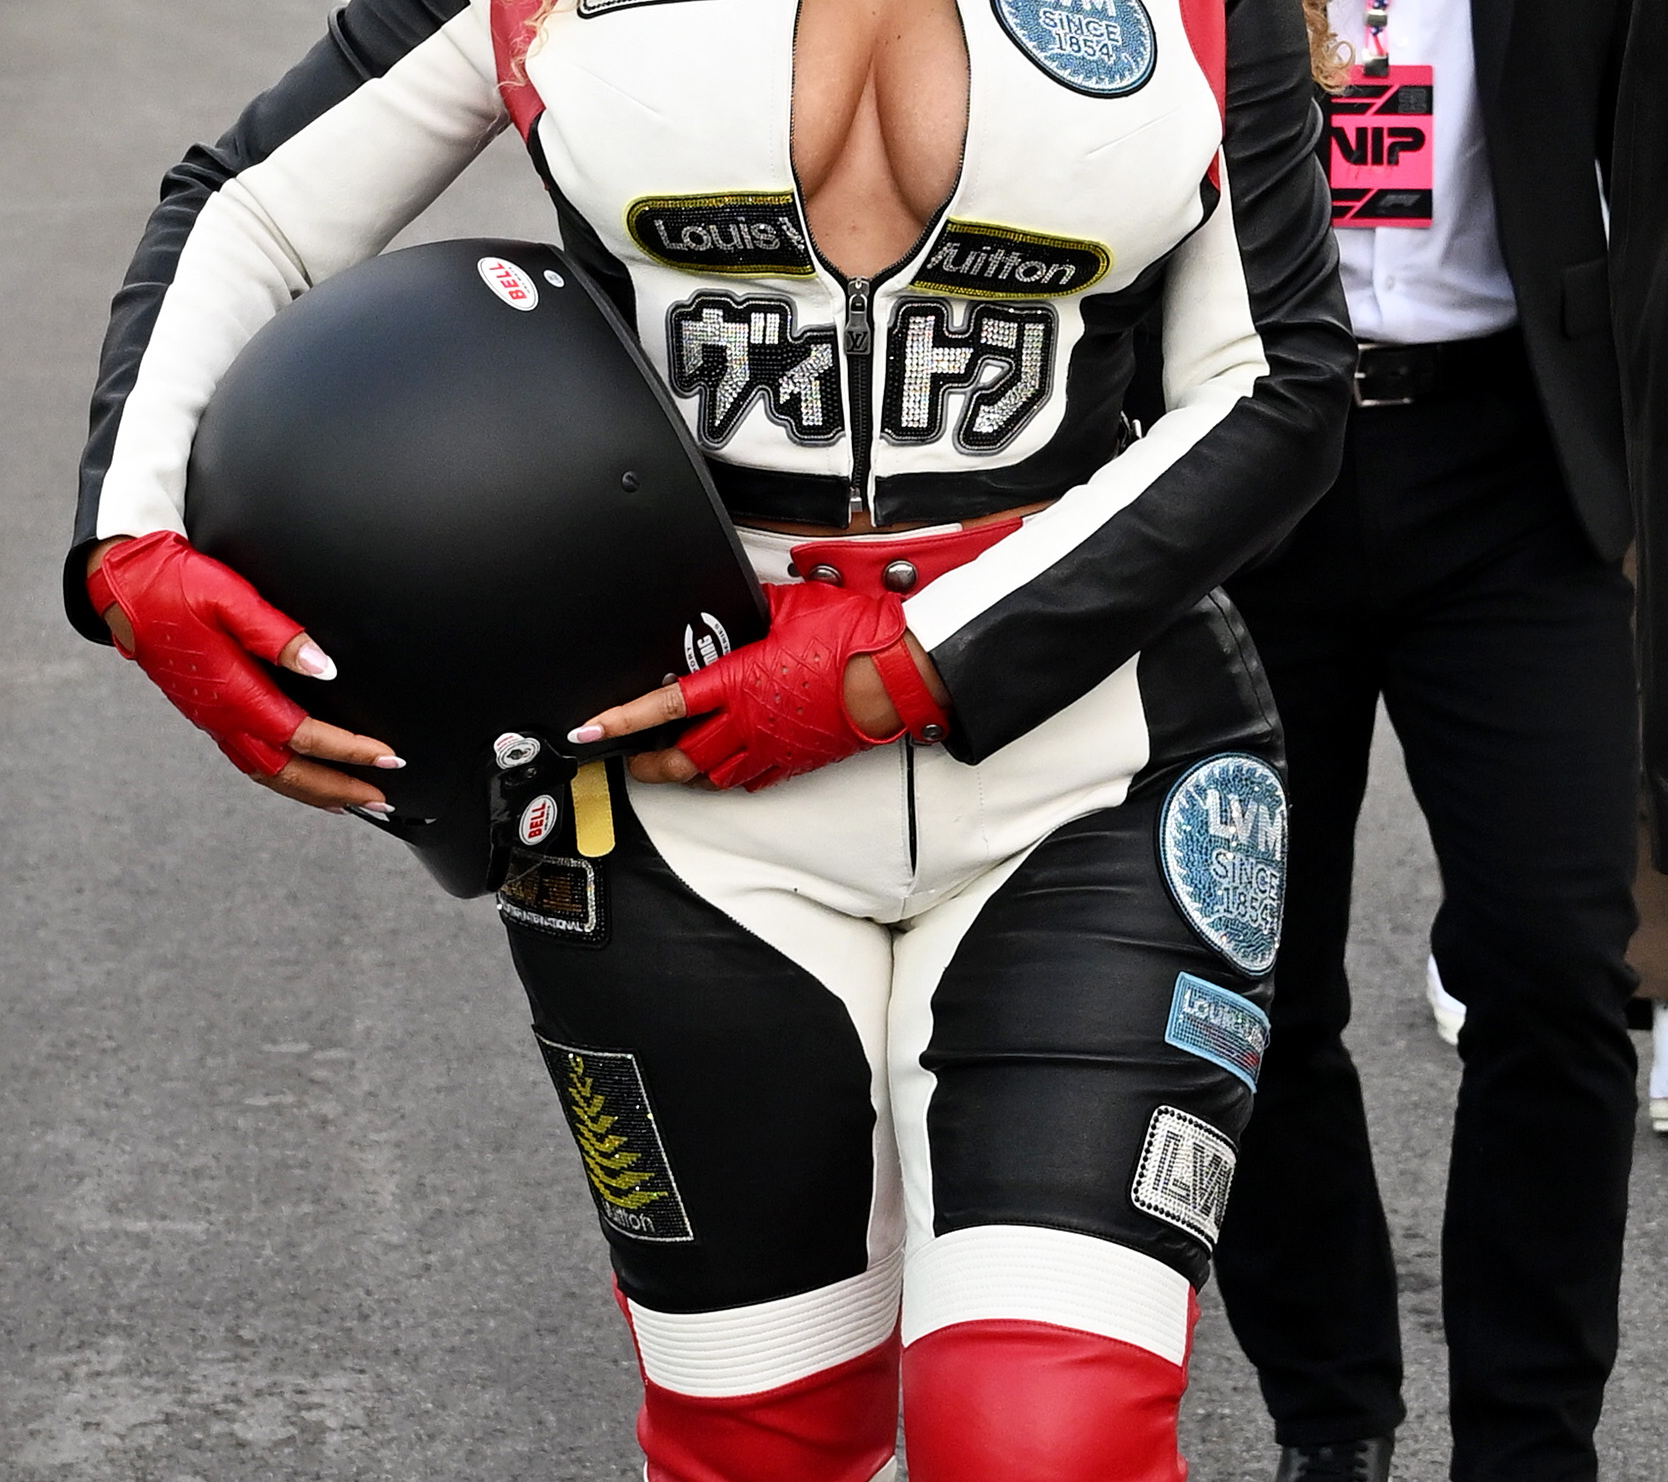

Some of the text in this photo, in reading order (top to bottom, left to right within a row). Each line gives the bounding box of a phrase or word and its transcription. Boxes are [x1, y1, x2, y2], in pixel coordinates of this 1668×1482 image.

[1041, 8, 1121, 44] SINCE
[1054, 31, 1115, 62] 1854
[654, 217, 780, 251] Louis
[489, 261, 527, 300] BELL
[528, 800, 547, 839] BELL
